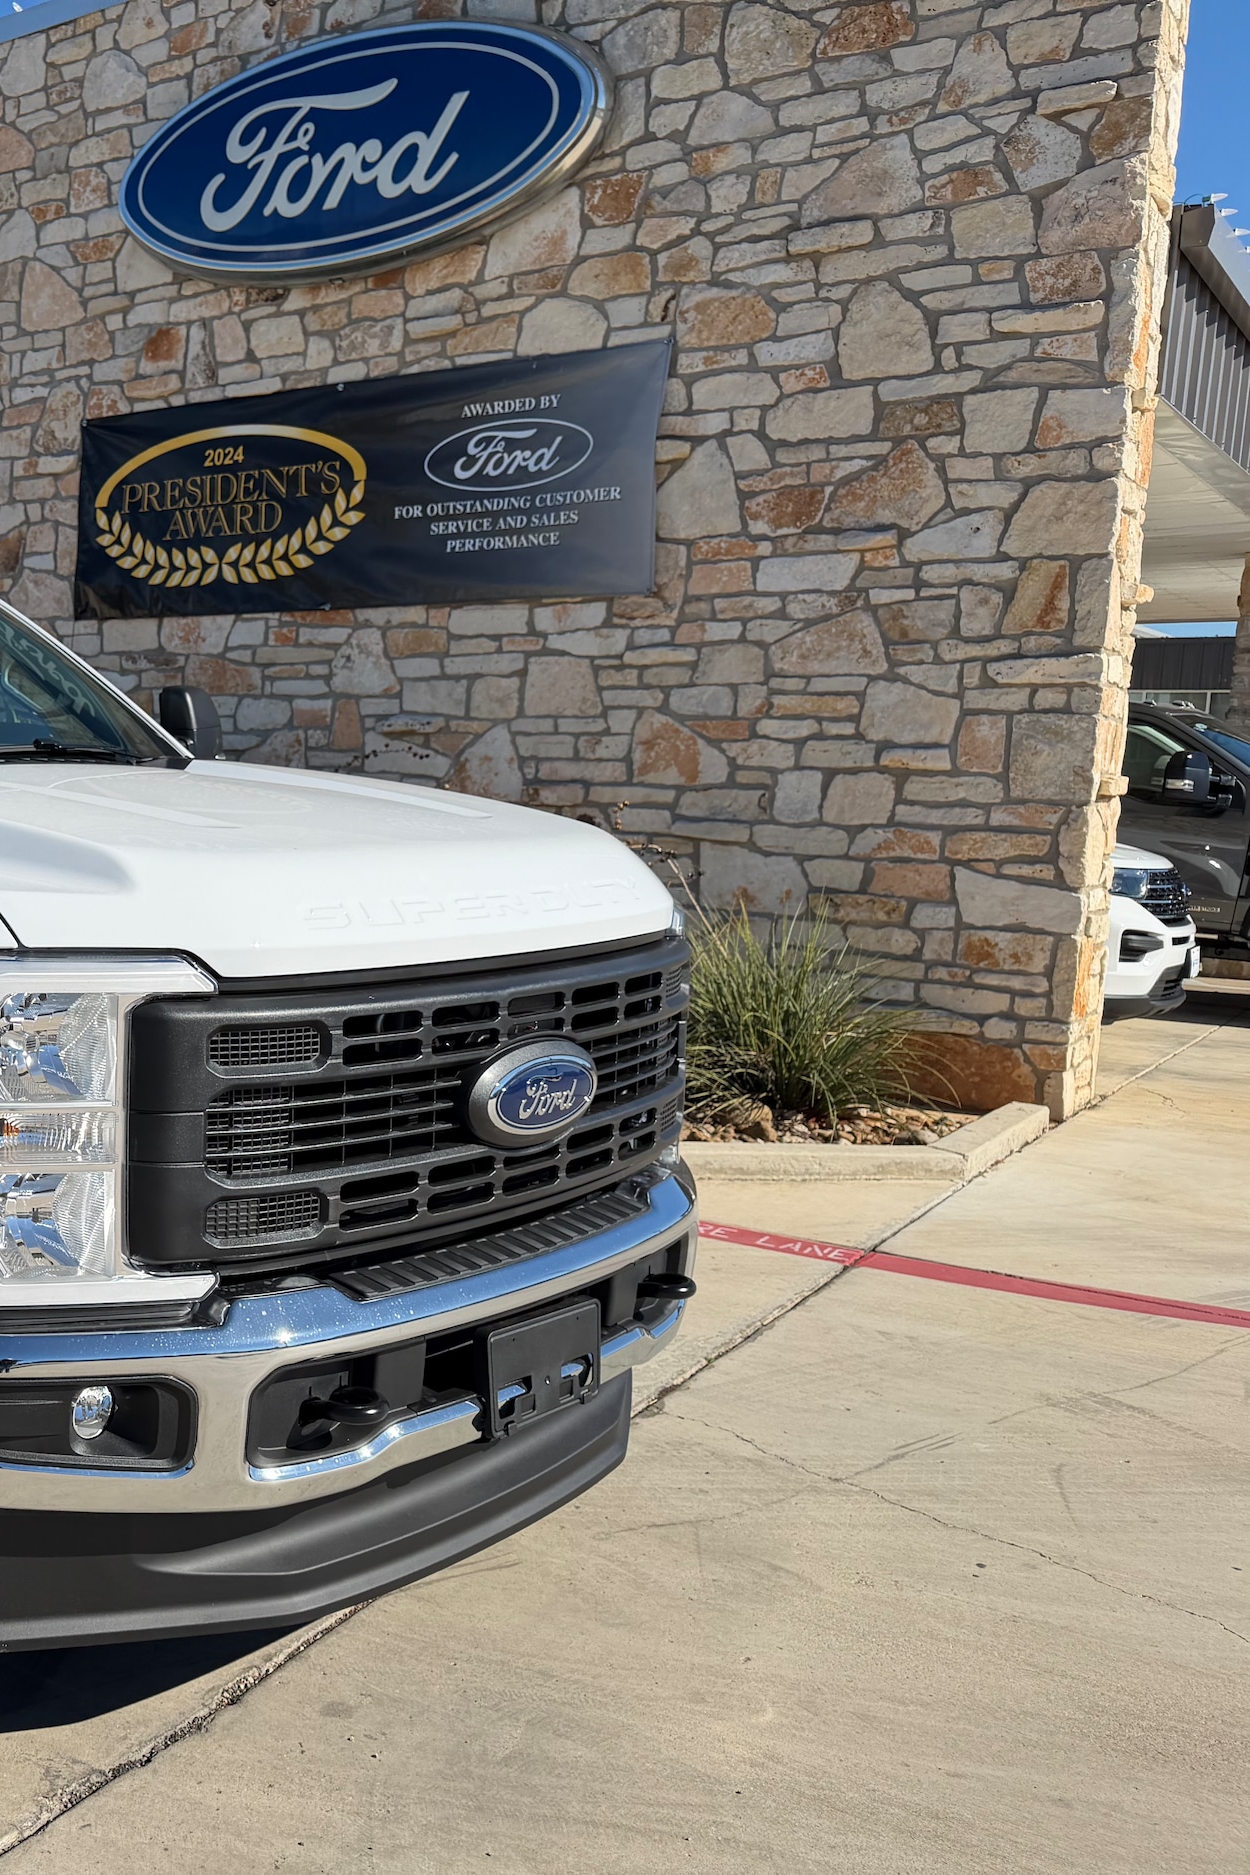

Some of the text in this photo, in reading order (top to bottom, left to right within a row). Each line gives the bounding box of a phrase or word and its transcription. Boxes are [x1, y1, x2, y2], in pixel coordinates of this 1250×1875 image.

[199, 78, 471, 232] Ford
[461, 394, 562, 418] AWARDED BY
[203, 446, 245, 467] 2024
[453, 428, 563, 480] Ford
[121, 460, 341, 515] PRESIDENT'S
[394, 486, 621, 519] FOR OUTSTANDING CUSTOMER
[162, 501, 283, 541] AWARD
[430, 510, 579, 535] SERVICE AND SALES
[446, 532, 560, 552] PERFORMANCE
[303, 876, 641, 931] SUPER DUTY
[519, 1072, 577, 1119] Ford
[755, 1235, 862, 1263] LANE
